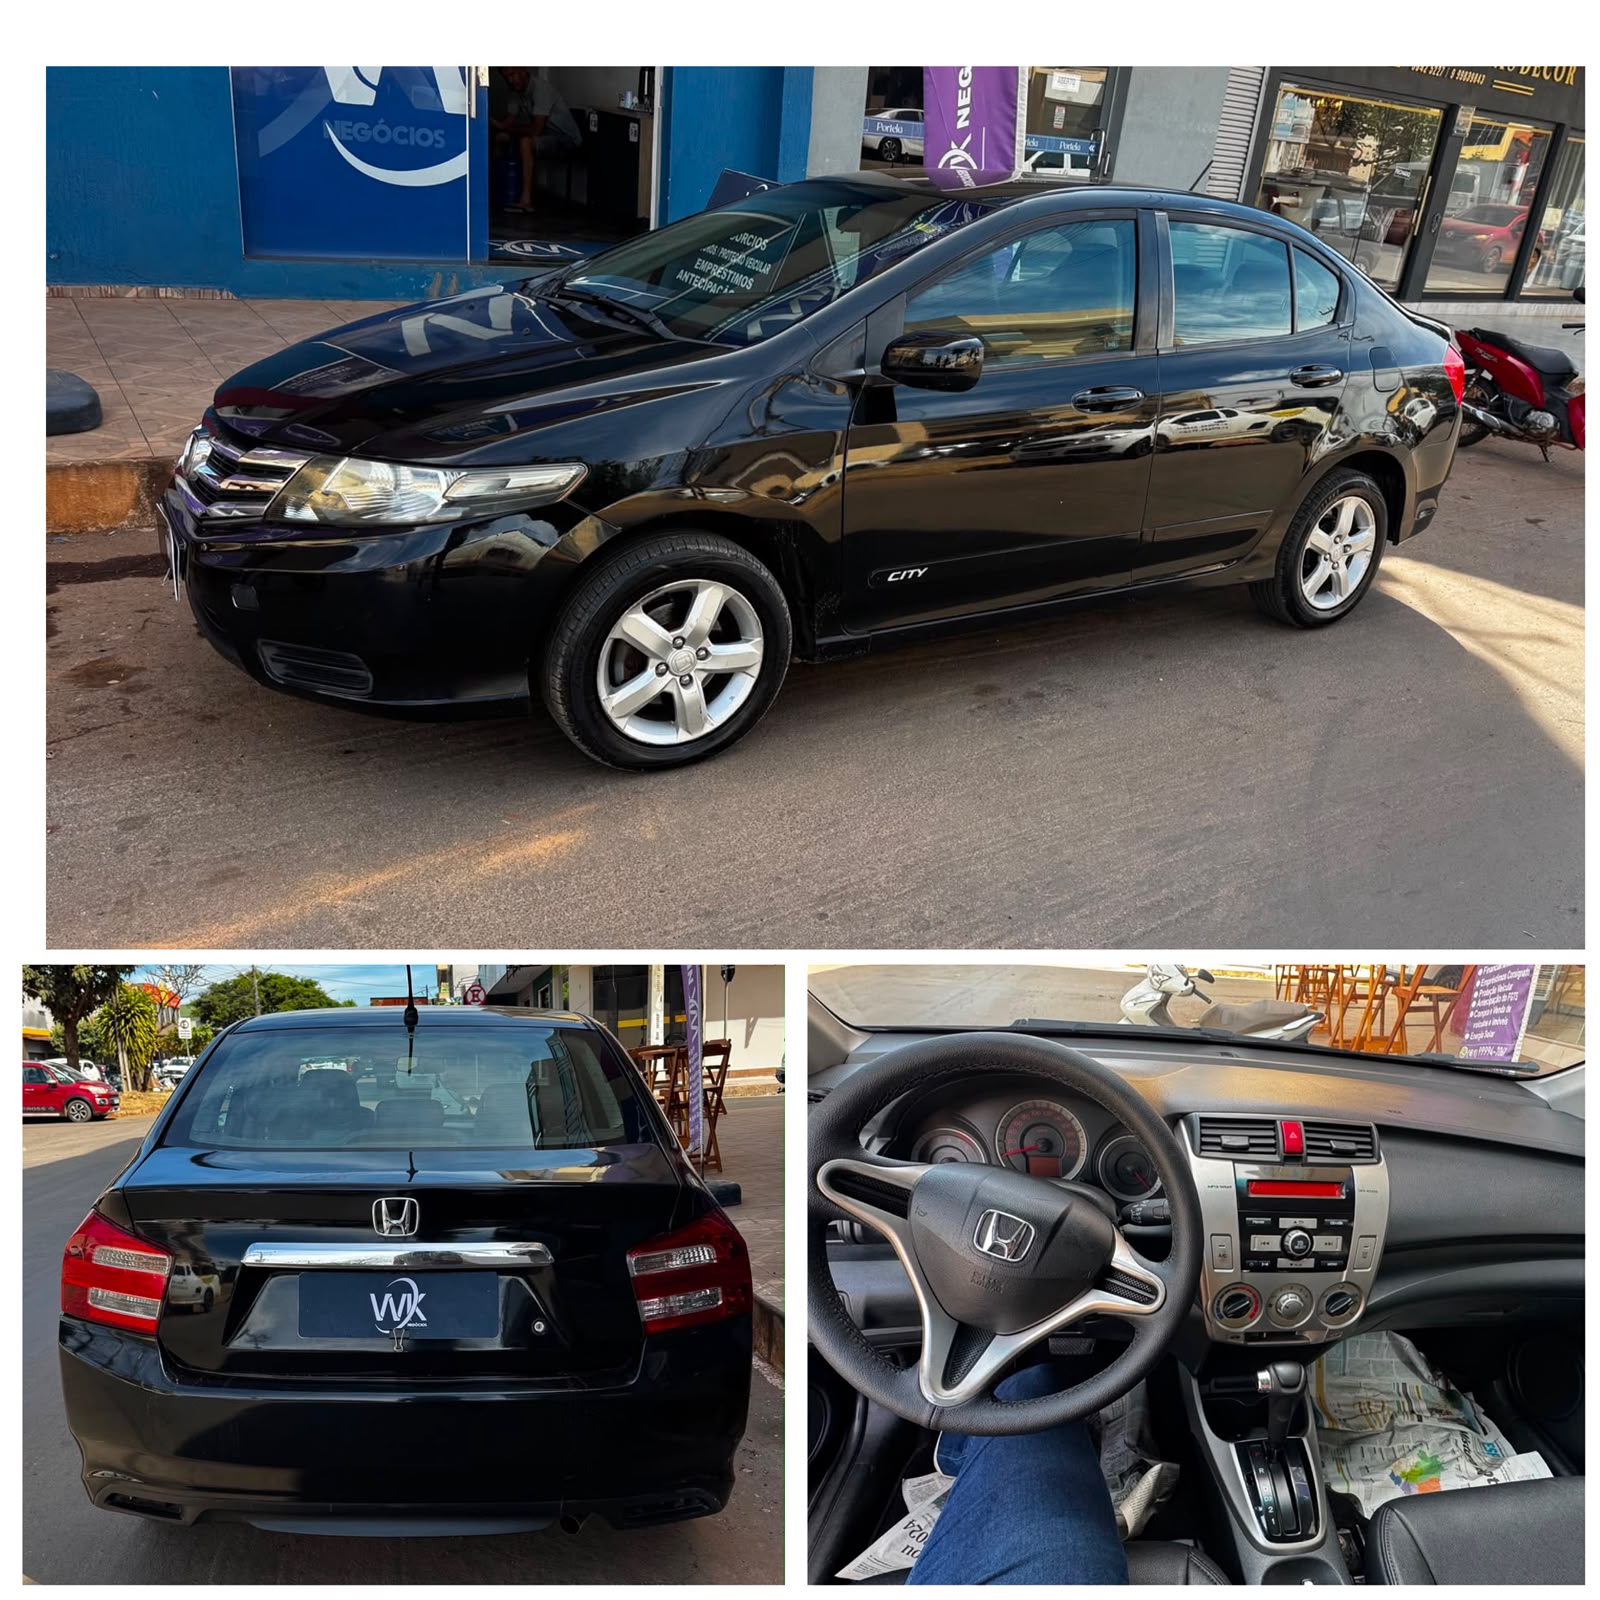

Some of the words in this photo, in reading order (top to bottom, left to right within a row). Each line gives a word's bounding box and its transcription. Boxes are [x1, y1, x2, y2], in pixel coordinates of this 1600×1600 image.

[322, 118, 446, 149] NEGÓCIOS
[887, 567, 928, 582] CITY
[903, 1519, 928, 1543] 024
